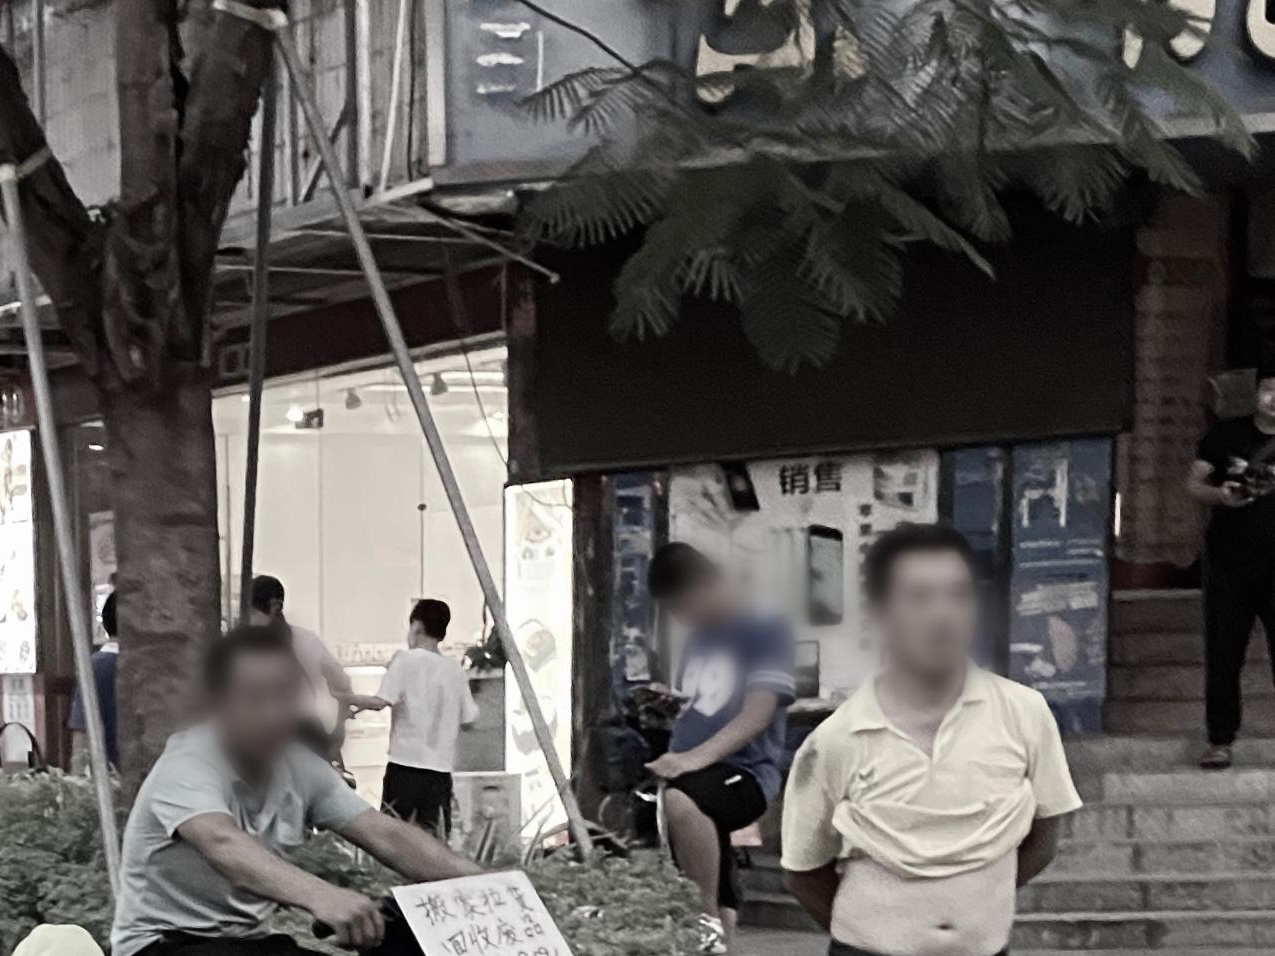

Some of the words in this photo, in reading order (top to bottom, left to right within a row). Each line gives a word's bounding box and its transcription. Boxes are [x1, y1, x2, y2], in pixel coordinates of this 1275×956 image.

[779, 462, 841, 495] 销售
[441, 914, 545, 956] 回收废品
